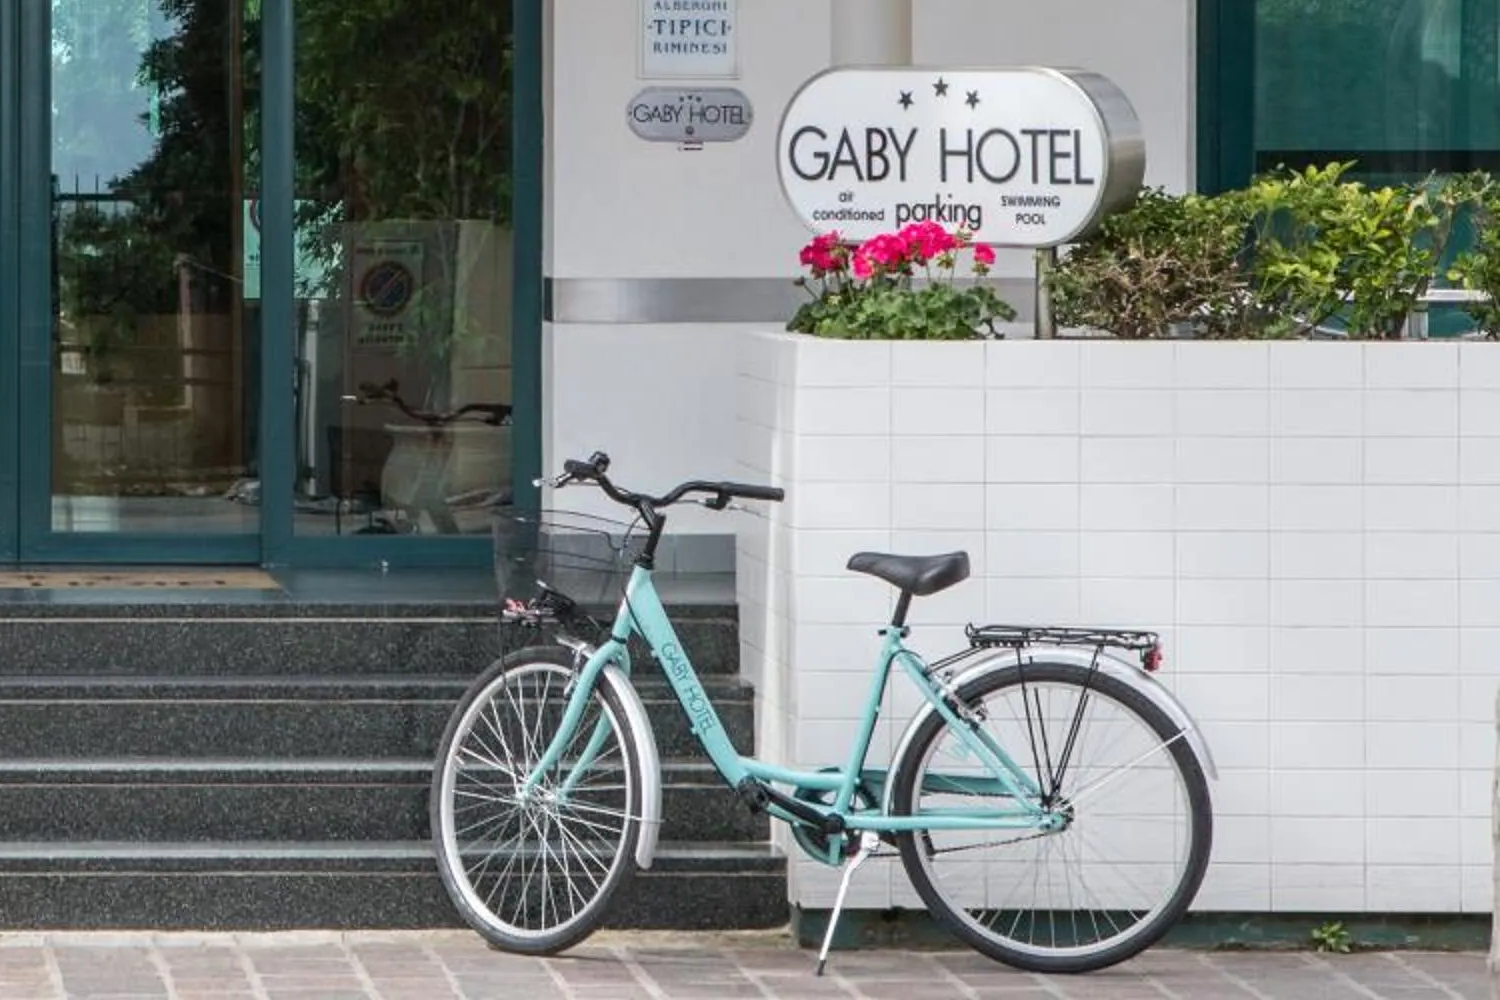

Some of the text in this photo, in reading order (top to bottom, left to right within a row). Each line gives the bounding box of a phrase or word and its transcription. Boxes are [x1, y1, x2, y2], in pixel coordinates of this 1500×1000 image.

[653, 0, 728, 11] ALBERGHI
[653, 19, 727, 36] TIPICI
[653, 41, 728, 54] RIMINESI
[633, 103, 749, 126] GABY HOTEL
[788, 125, 1095, 186] GABY HOTEL
[838, 189, 854, 203] air
[1001, 194, 1061, 208] SWIMMING
[812, 206, 885, 221] conditioned
[895, 192, 983, 231] parking
[1015, 213, 1046, 225] POOL
[661, 642, 716, 734] GABY HOTEL
